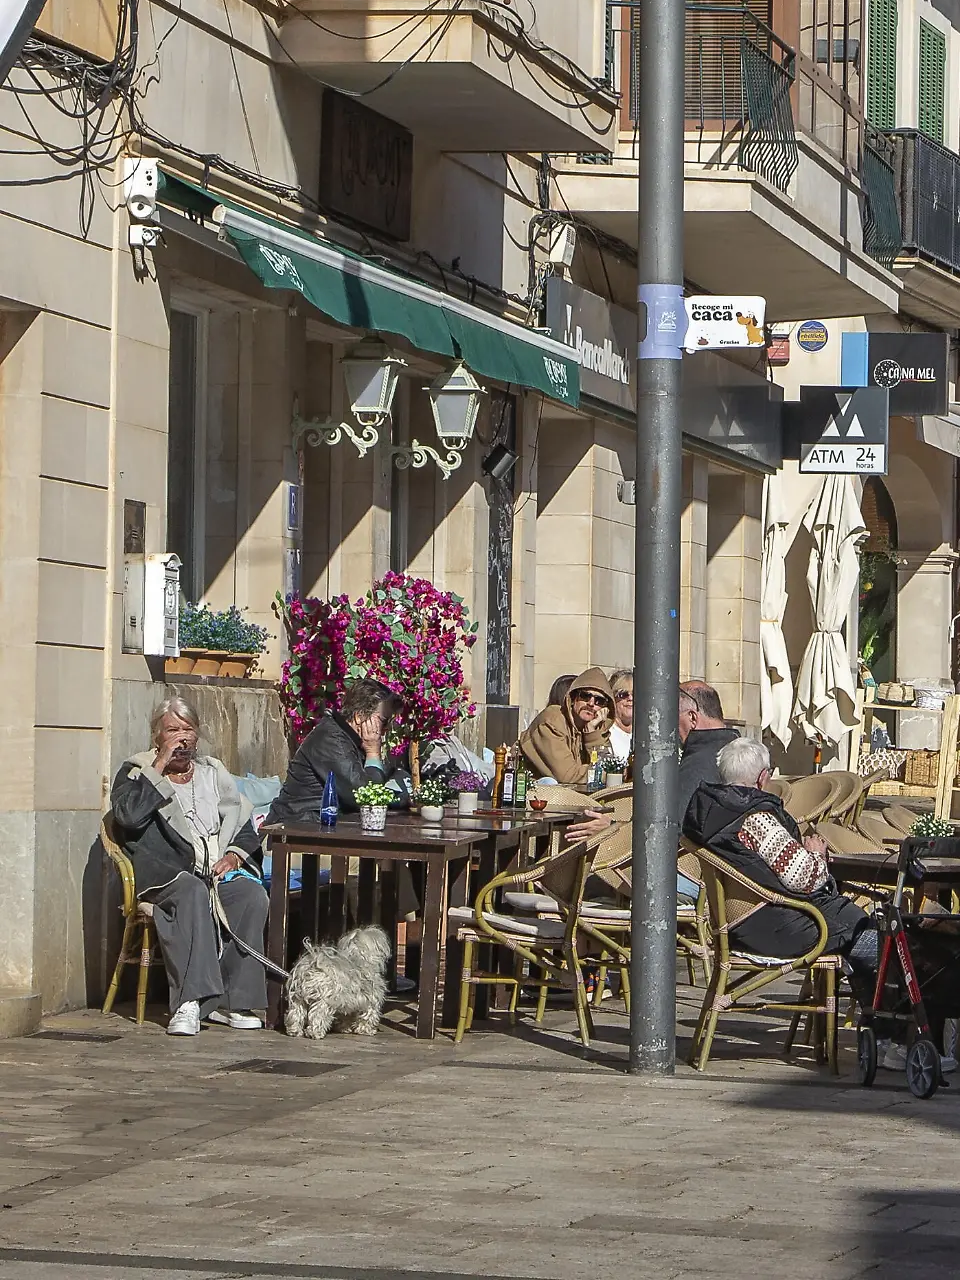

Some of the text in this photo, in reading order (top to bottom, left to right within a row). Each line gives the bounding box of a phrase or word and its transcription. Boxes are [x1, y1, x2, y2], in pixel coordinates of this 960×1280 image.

[691, 303, 721, 311] Recoge
[691, 310, 734, 321] caca
[916, 367, 936, 380] MEL
[809, 447, 876, 464] ATM 24
